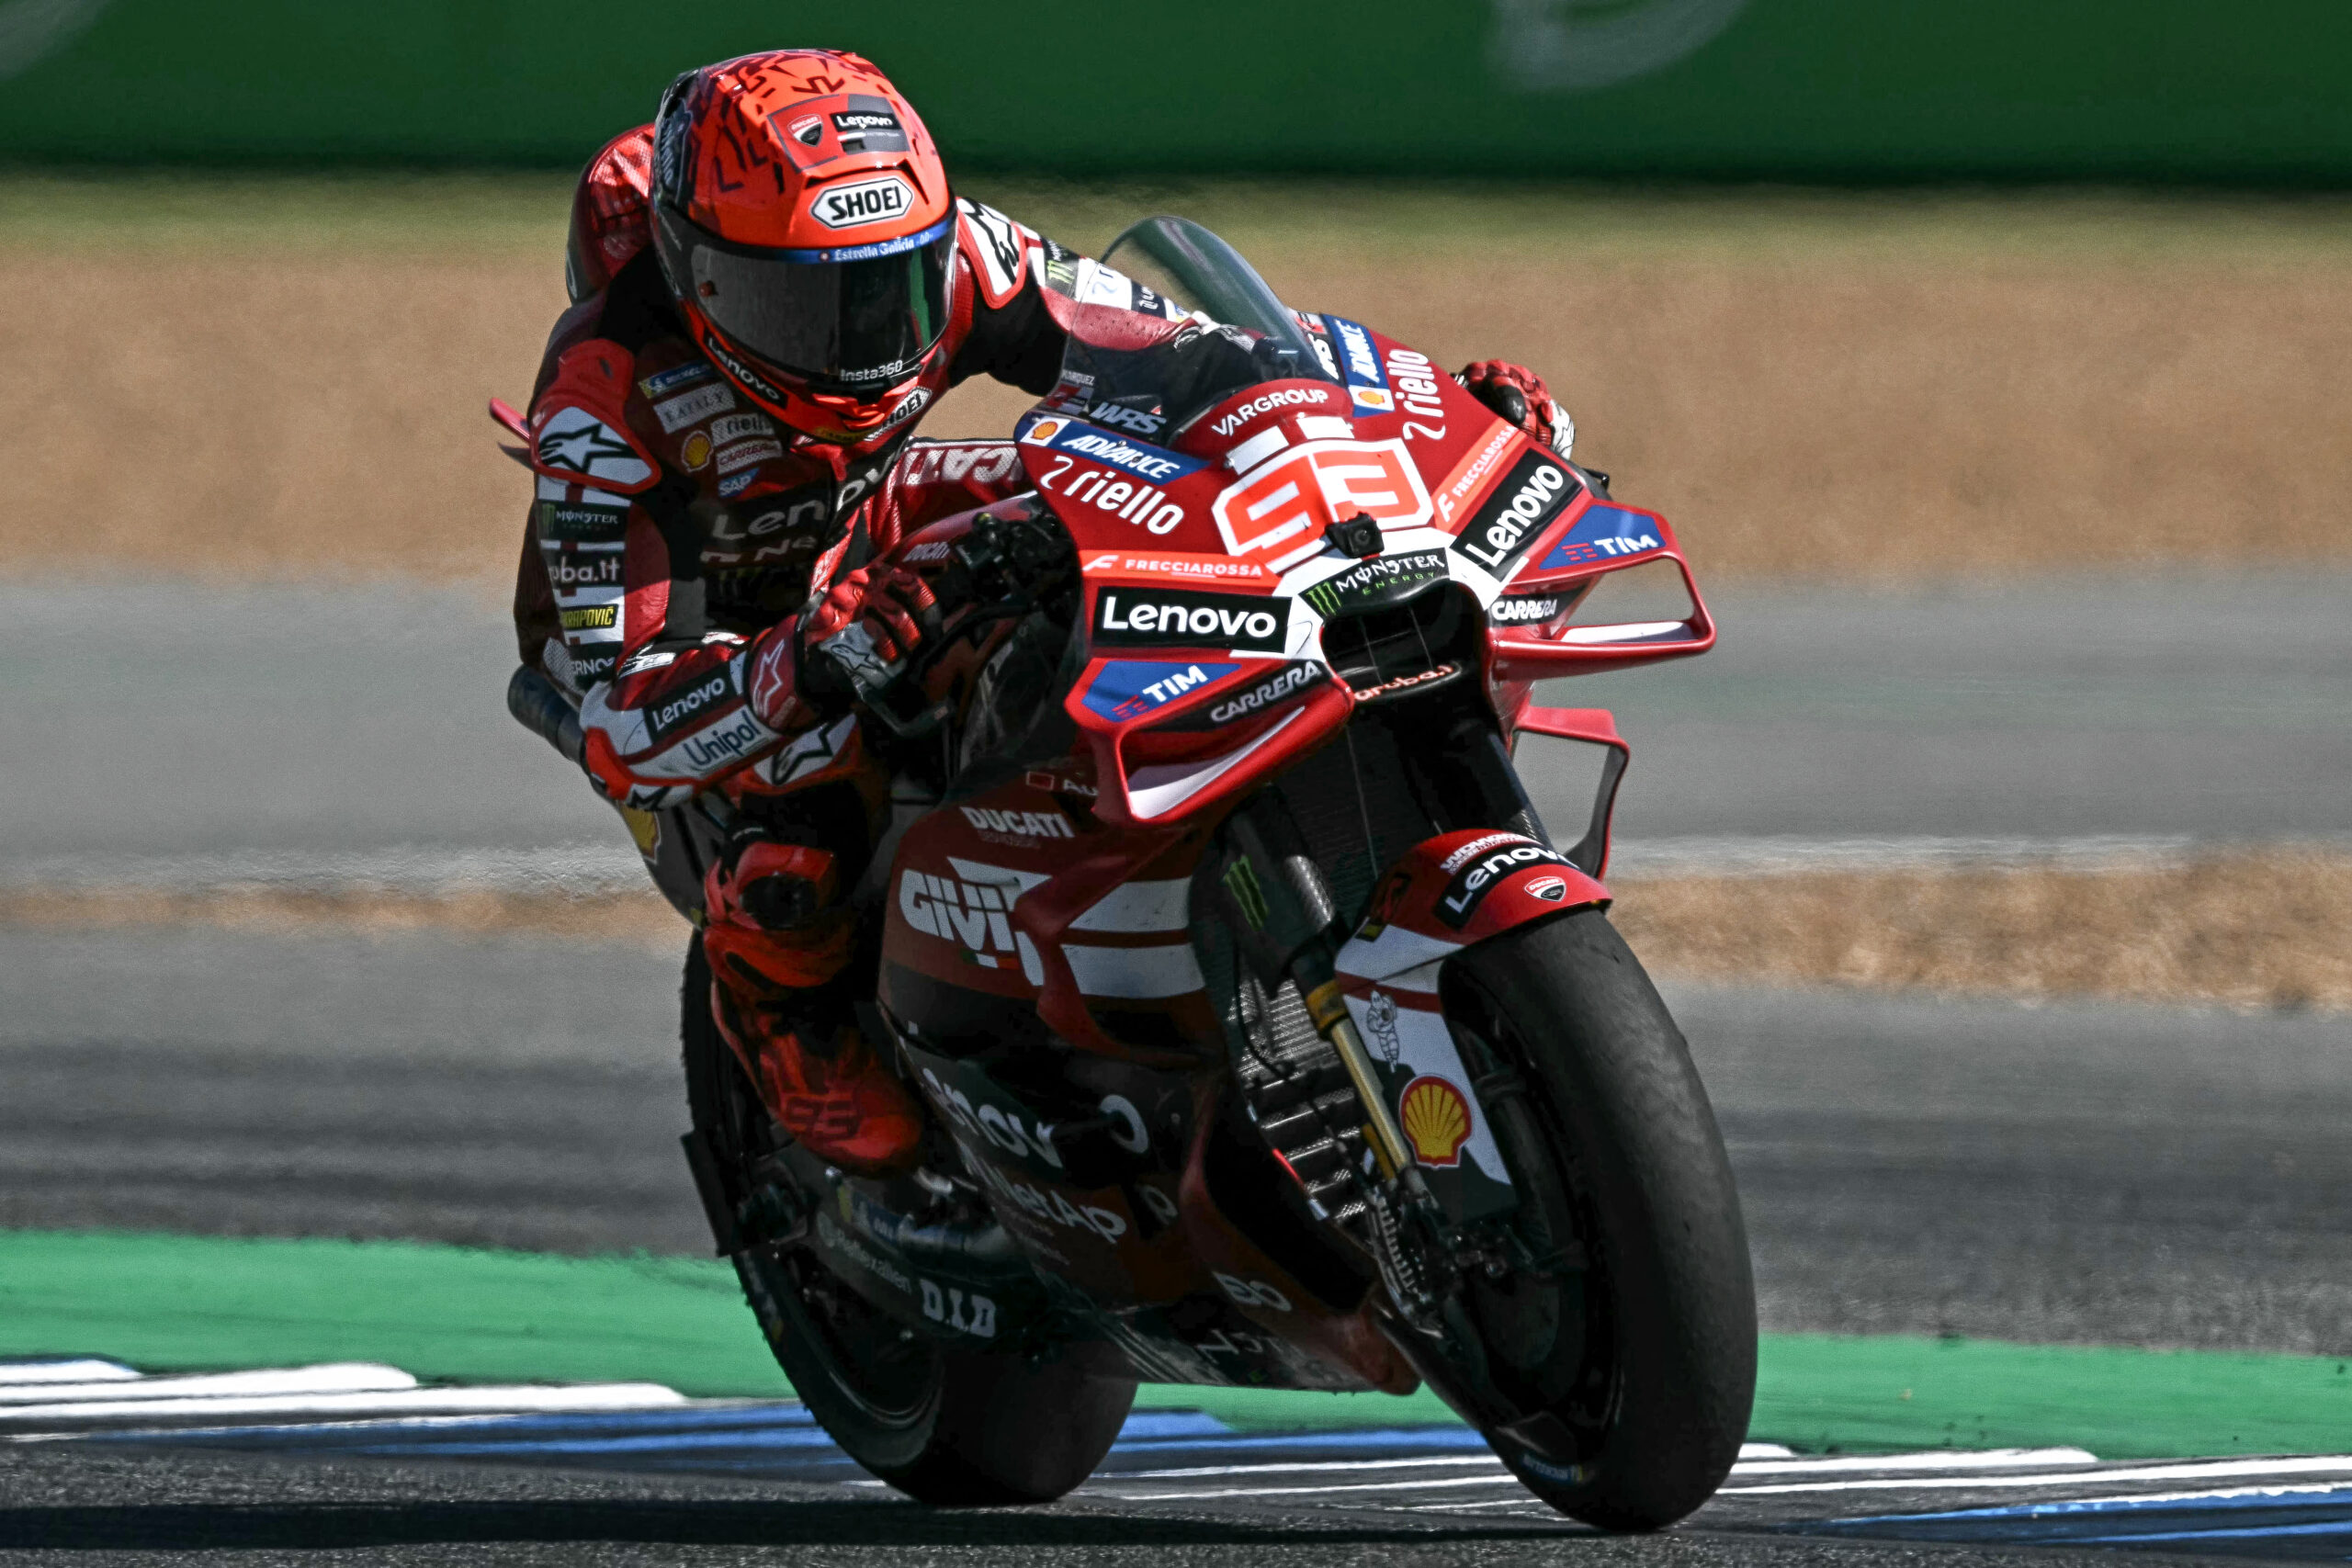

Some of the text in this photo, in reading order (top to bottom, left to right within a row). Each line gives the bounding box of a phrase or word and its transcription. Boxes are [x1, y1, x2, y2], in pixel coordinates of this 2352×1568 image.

[828, 186, 902, 220] SHOEI
[834, 247, 878, 262] Estrella
[878, 237, 915, 256] Galicia
[708, 336, 781, 400] Lenovo
[840, 360, 903, 381] Insta360
[1386, 349, 1447, 418] riello
[1090, 401, 1167, 434] WRS
[1211, 389, 1329, 436] VARGROUP
[1061, 434, 1181, 479] ADVANCE
[1453, 424, 1519, 497] FRECCIAROSSA
[556, 511, 617, 525] MONSTER
[1063, 470, 1184, 535] riello
[1213, 439, 1433, 571] 93
[1464, 465, 1564, 568] Lenovo
[1594, 535, 1658, 555] TIM
[1125, 559, 1262, 577] FRECCIAROSSA
[1336, 554, 1445, 592] MONSTER
[1362, 571, 1435, 595] ENERGY
[1102, 596, 1277, 638] Lenovo
[1492, 598, 1558, 621] CARRERA
[1143, 665, 1208, 702] TIM
[1210, 660, 1323, 722] CARRERA
[650, 677, 726, 731] Lenovo
[684, 710, 762, 767] Unipol
[958, 806, 1075, 839] DUCATI
